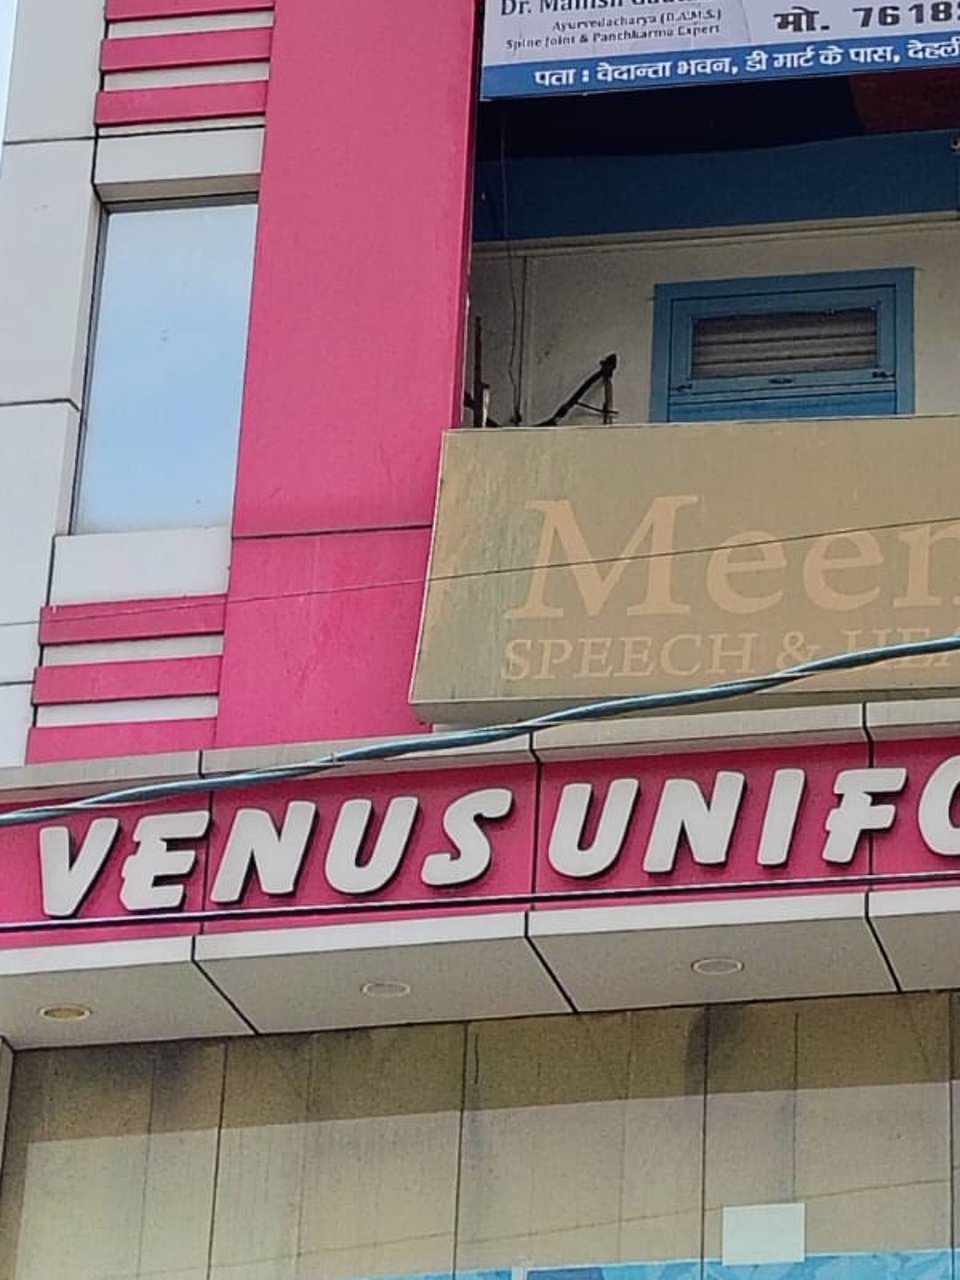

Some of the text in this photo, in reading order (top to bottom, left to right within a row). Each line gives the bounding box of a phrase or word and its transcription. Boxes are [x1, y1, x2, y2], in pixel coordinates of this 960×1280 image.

[579, 33, 589, 44] &
[774, 6, 831, 32] मो.
[534, 68, 577, 87] पता
[596, 61, 672, 83] वेदान्ता
[677, 56, 739, 76] भवन,
[745, 49, 768, 72] डी
[773, 44, 817, 69] मार्ट
[819, 44, 845, 66] के
[849, 45, 901, 64] पास,
[500, 632, 760, 681] SPEECH
[776, 630, 820, 675] &
[38, 788, 513, 918] VENUS
